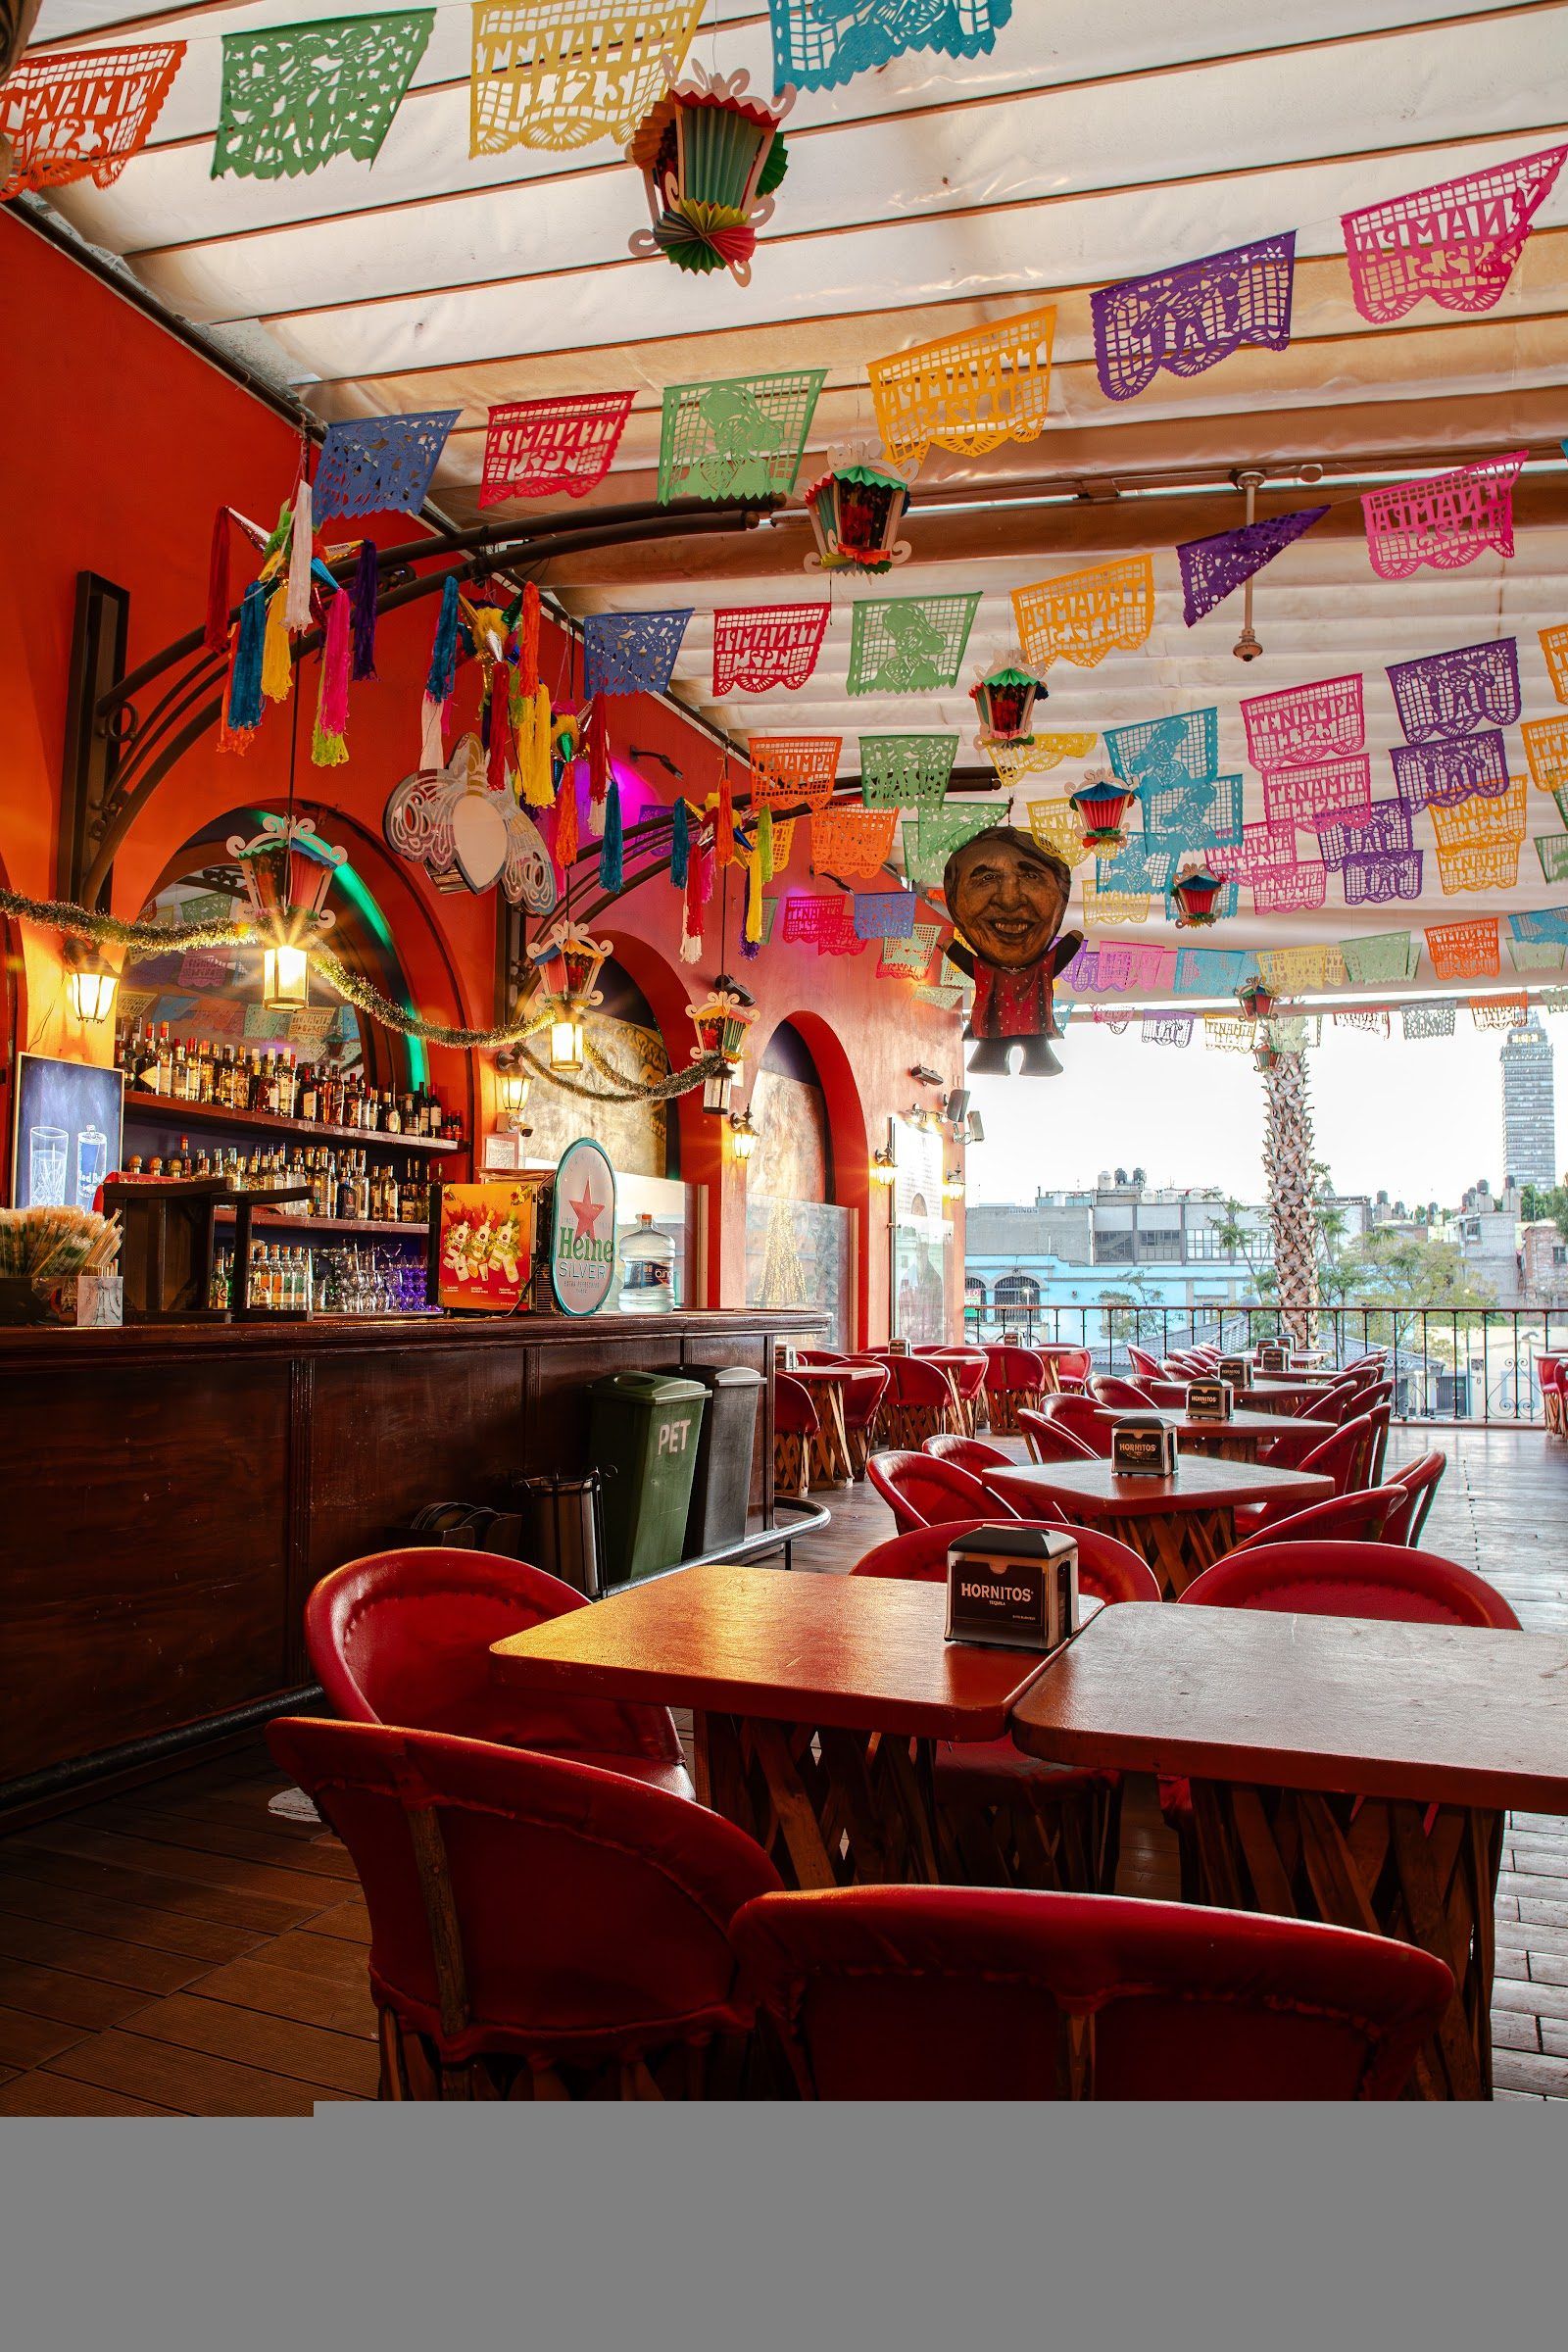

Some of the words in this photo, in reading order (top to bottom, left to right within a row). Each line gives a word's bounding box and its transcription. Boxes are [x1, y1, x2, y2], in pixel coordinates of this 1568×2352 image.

[474, 12, 691, 75] TENAMPA
[1250, 694, 1359, 735] TENAMPA
[753, 753, 833, 774] TENAMPA
[1268, 772, 1366, 805] TENAMPA
[1207, 834, 1292, 861] TENAMPA
[1441, 851, 1516, 871] TENAMPA
[559, 1226, 613, 1262] Heine
[1191, 1395, 1217, 1403] HORNITOS
[658, 1420, 691, 1455] PET
[1119, 1443, 1156, 1452] HORNITOS
[961, 1583, 1032, 1602] HORNITOS
